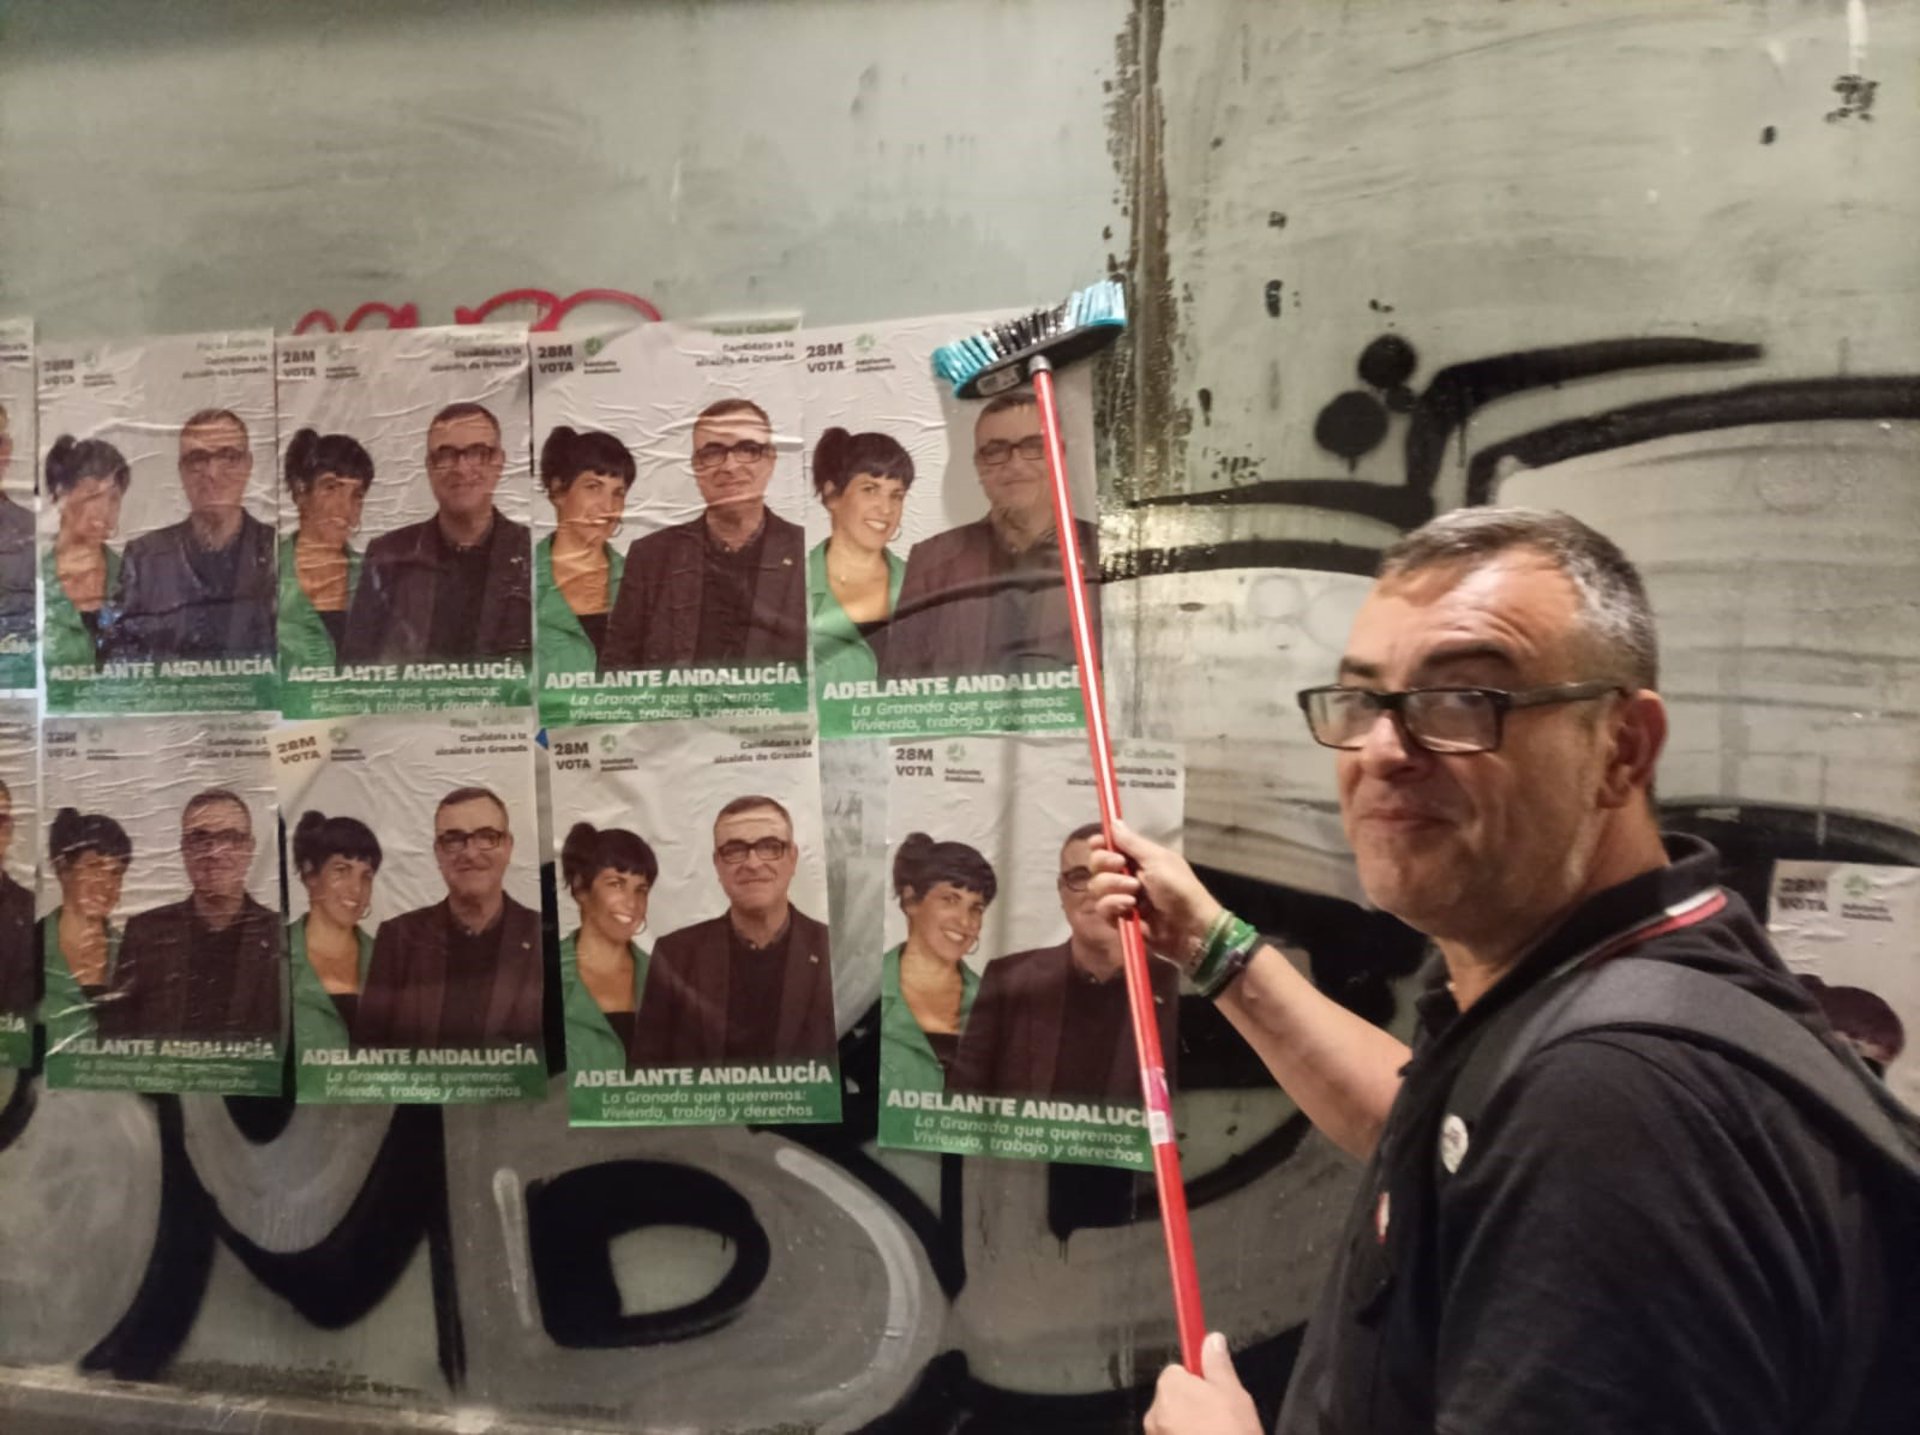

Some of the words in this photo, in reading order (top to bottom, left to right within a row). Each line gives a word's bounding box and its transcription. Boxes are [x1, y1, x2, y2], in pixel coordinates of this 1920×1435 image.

[538, 344, 573, 358] 28M
[806, 342, 843, 358] 28M
[538, 362, 574, 374] VOTA
[806, 360, 846, 373] VOTA
[288, 664, 398, 682] ADELANTE
[402, 657, 526, 680] ANDALUCÍA
[545, 669, 662, 689] ADELANTE
[667, 662, 801, 686] ANDALUCÍA
[823, 676, 950, 700] ADELANTE
[955, 665, 1081, 694] ANDALUCÍ
[570, 693, 588, 706] La
[594, 690, 657, 705] Granada
[661, 691, 688, 707] que
[569, 709, 633, 721] Vivienda,
[852, 704, 871, 717] La
[876, 699, 944, 714] Granada
[948, 698, 979, 716] que
[850, 717, 920, 732] Vivienda,
[926, 714, 983, 730] trabajo
[987, 714, 999, 729] y
[1001, 710, 1076, 726] derechos
[276, 735, 317, 755] 28M
[554, 741, 589, 755] 28M
[279, 749, 321, 765] VOTA
[769, 750, 812, 760] Granada
[896, 747, 934, 762] 28M
[556, 758, 592, 770] VOTA
[895, 765, 934, 777] VOTA
[302, 1047, 411, 1066] ADELANTE
[416, 1043, 538, 1065] ANDALUCÍA
[326, 1070, 343, 1083] La
[348, 1069, 407, 1083] Granada
[410, 1071, 437, 1086] que
[441, 1071, 514, 1085] queremos:
[574, 1068, 694, 1087] ADELANTE
[699, 1060, 833, 1085] ANDALUCÍA
[325, 1085, 385, 1099] Vivienda,
[390, 1084, 441, 1100] trabajo
[443, 1086, 453, 1100] y
[456, 1084, 522, 1098] derechos
[602, 1093, 620, 1105] La
[624, 1091, 689, 1104] Granada
[694, 1091, 721, 1105] que
[726, 1089, 807, 1104] queremos:
[886, 1088, 1017, 1117] ADELANTE
[602, 1106, 667, 1121] Vivienda,
[672, 1105, 727, 1121] trabajo
[730, 1106, 741, 1121] y
[743, 1104, 814, 1117] derechos
[914, 1114, 935, 1128] La
[940, 1116, 1009, 1135] Granada
[1014, 1124, 1044, 1140] que
[1050, 1125, 1138, 1146] queremos:
[913, 1129, 984, 1150] Vivienda,
[990, 1136, 1049, 1156] trabajo
[1053, 1144, 1065, 1158] y
[1067, 1144, 1143, 1164] derechos
